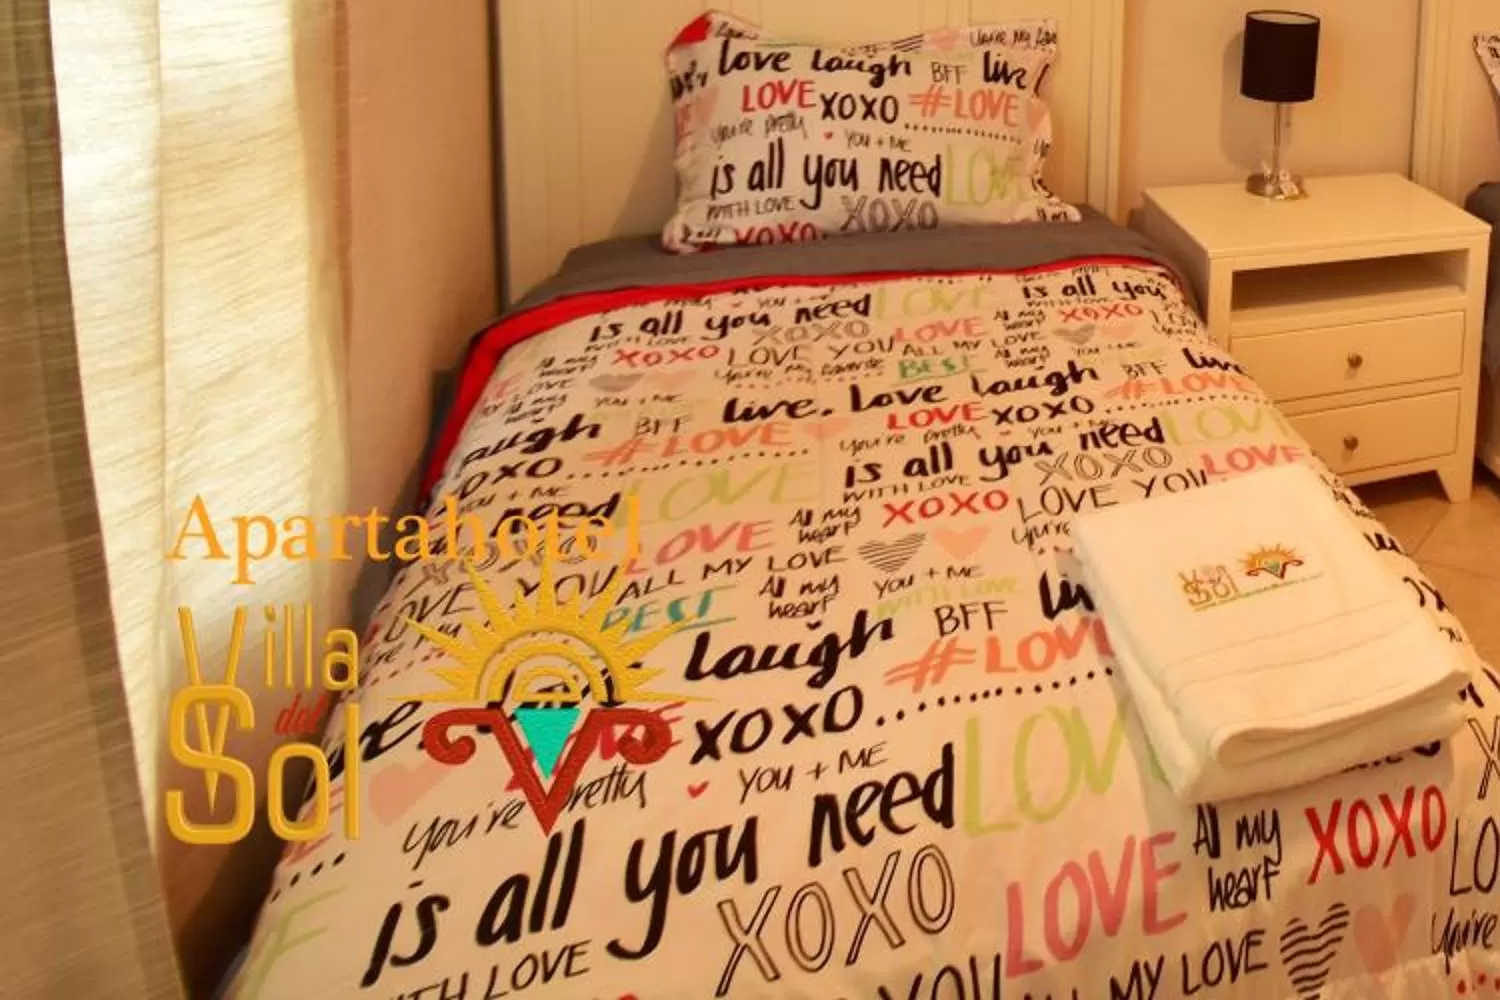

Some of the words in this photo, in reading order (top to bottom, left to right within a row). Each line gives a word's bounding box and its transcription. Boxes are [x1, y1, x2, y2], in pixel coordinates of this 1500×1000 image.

[718, 38, 791, 76] love
[811, 48, 911, 88] laugh
[930, 61, 968, 84] BFF
[741, 78, 816, 113] LOVE
[820, 91, 899, 124] XOXO
[908, 83, 1020, 128] #LOVE
[710, 155, 735, 199] is
[748, 137, 785, 192] all
[799, 154, 858, 210] you
[879, 154, 941, 197] need
[1062, 274, 1096, 298] all
[589, 323, 623, 342] is
[640, 310, 683, 335] all
[701, 306, 771, 340] you
[795, 293, 871, 324] need
[895, 316, 988, 343] LOVE
[1058, 303, 1143, 322] XOXO
[612, 344, 720, 367] XOXO
[828, 337, 895, 360] YOU
[850, 383, 949, 413] love
[970, 360, 1100, 397] laugh
[635, 416, 692, 436] BFF
[885, 401, 989, 430] LOVE
[991, 395, 1095, 426] XOXO
[582, 421, 793, 466] #LOVE
[844, 457, 883, 489] is
[902, 441, 953, 477] all
[978, 441, 1053, 483] you
[1080, 416, 1166, 450] need
[1034, 446, 1173, 487] XOXO
[843, 484, 910, 504] WITH
[918, 475, 972, 492] LOVE
[882, 488, 1010, 529] XOXO
[1015, 484, 1119, 524] LOVE
[624, 519, 774, 578] LOVE
[616, 569, 686, 605] ALL
[702, 556, 752, 581] MY
[767, 546, 849, 572] LOVE
[875, 574, 915, 600] YOU
[948, 566, 986, 580] ME
[934, 601, 1009, 638] BFF
[684, 609, 893, 690] laugh
[689, 685, 864, 765] XOXO
[739, 764, 793, 805] YOU
[838, 742, 889, 776] ME
[1236, 808, 1284, 867] my
[1304, 783, 1449, 886] XOXO
[360, 879, 451, 989] is
[476, 819, 586, 948] all
[605, 815, 758, 960] you
[808, 742, 955, 869] need
[714, 843, 955, 999] XOXO
[1005, 830, 1188, 980] LOVE
[485, 939, 592, 1000] LOVE
[1182, 929, 1269, 996] LOVE
